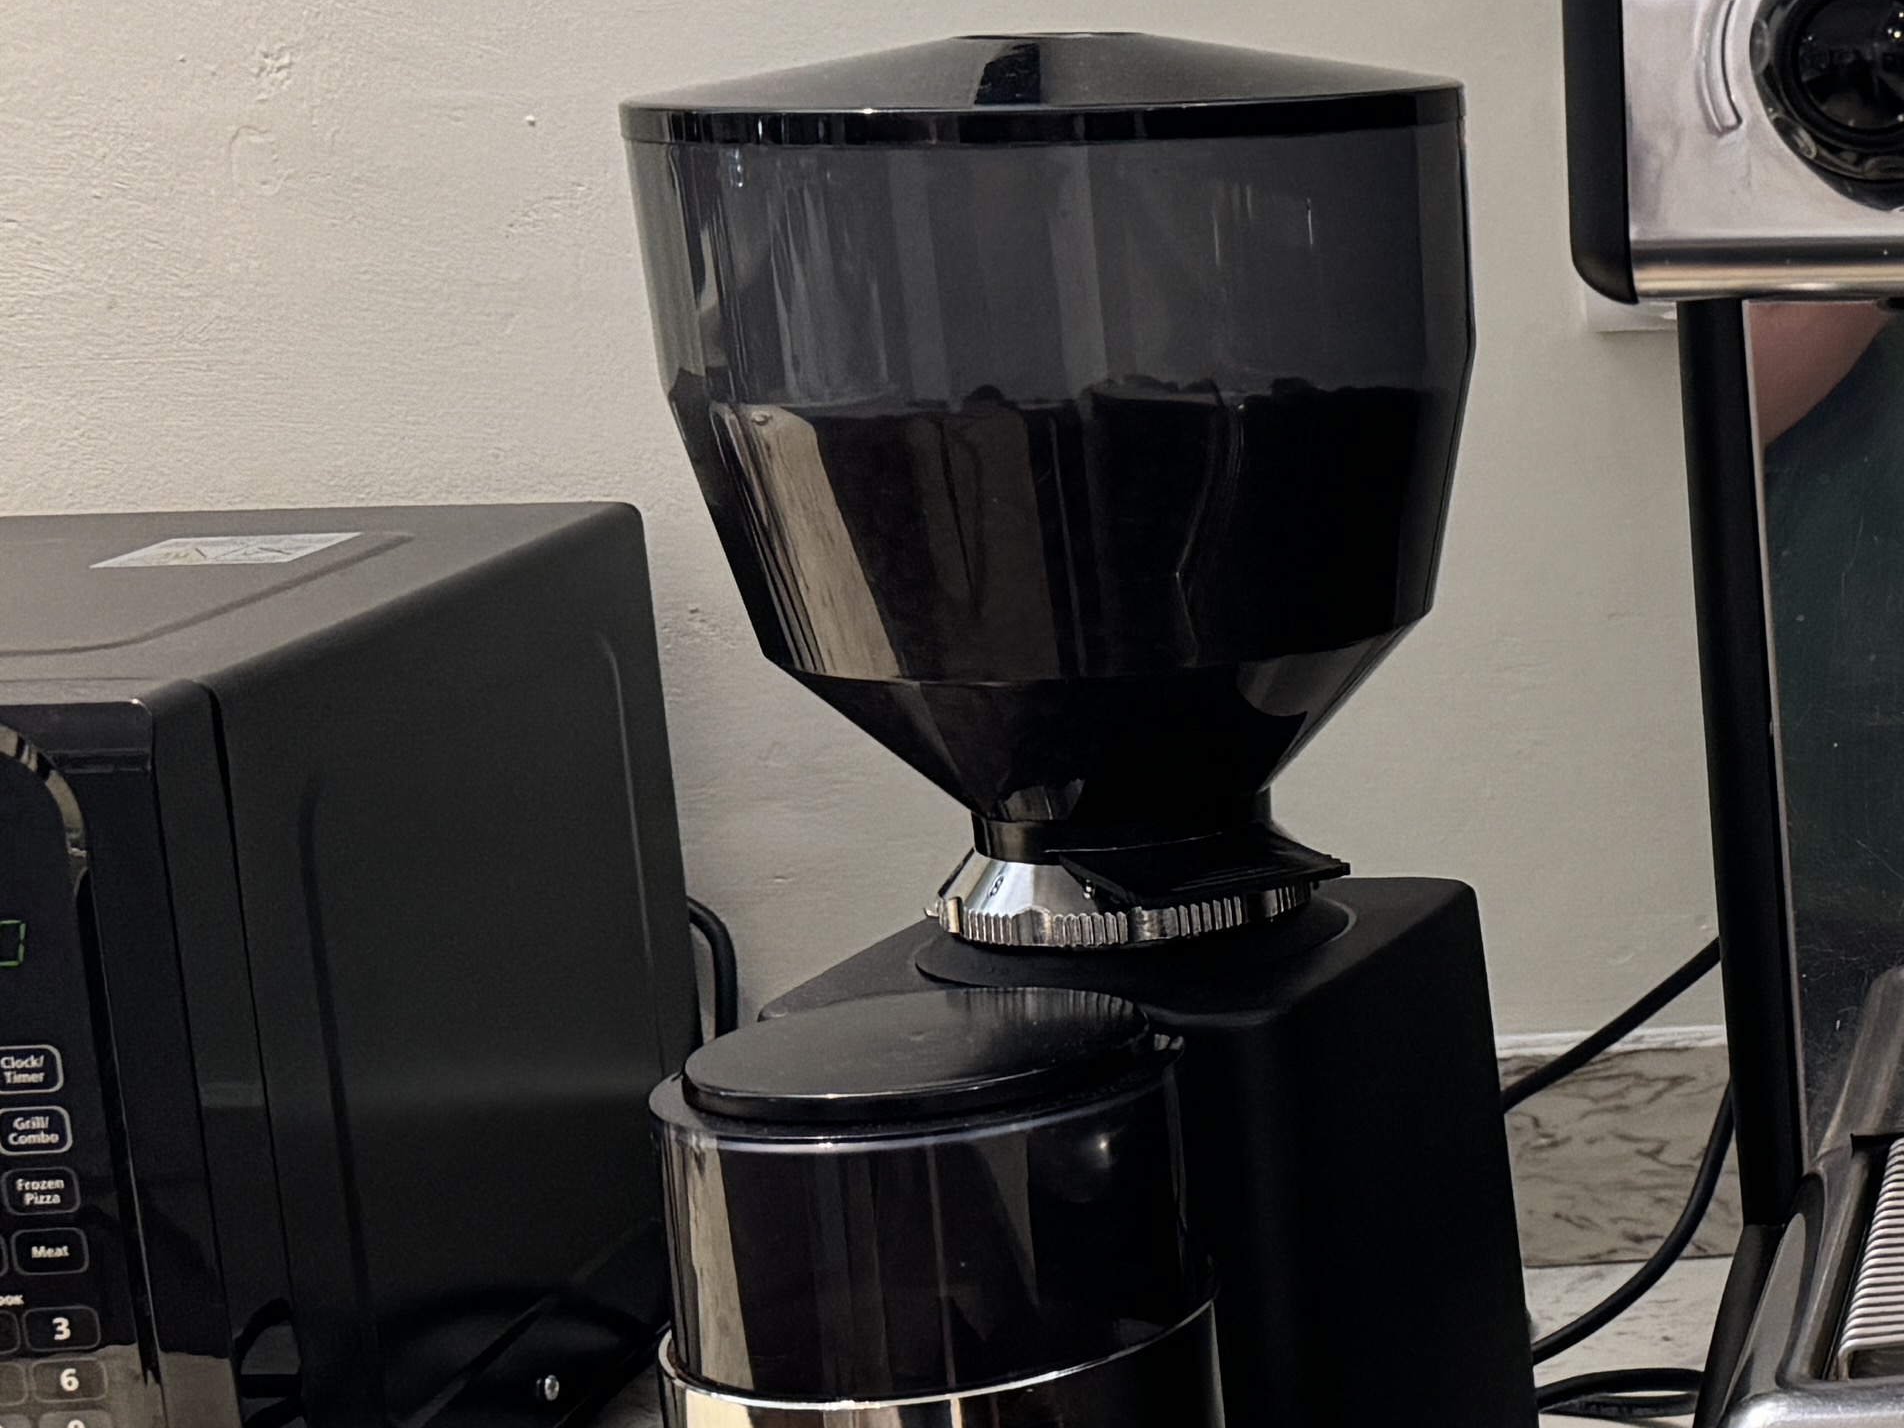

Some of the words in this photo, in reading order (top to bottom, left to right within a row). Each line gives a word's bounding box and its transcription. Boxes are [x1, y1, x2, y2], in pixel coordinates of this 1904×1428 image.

[8, 1131, 60, 1145] Combo
[16, 1178, 65, 1191] Frozen
[24, 1192, 61, 1205] Pizza
[31, 1245, 70, 1259] Meat
[52, 1317, 71, 1341] 3
[60, 1368, 79, 1392] 6
